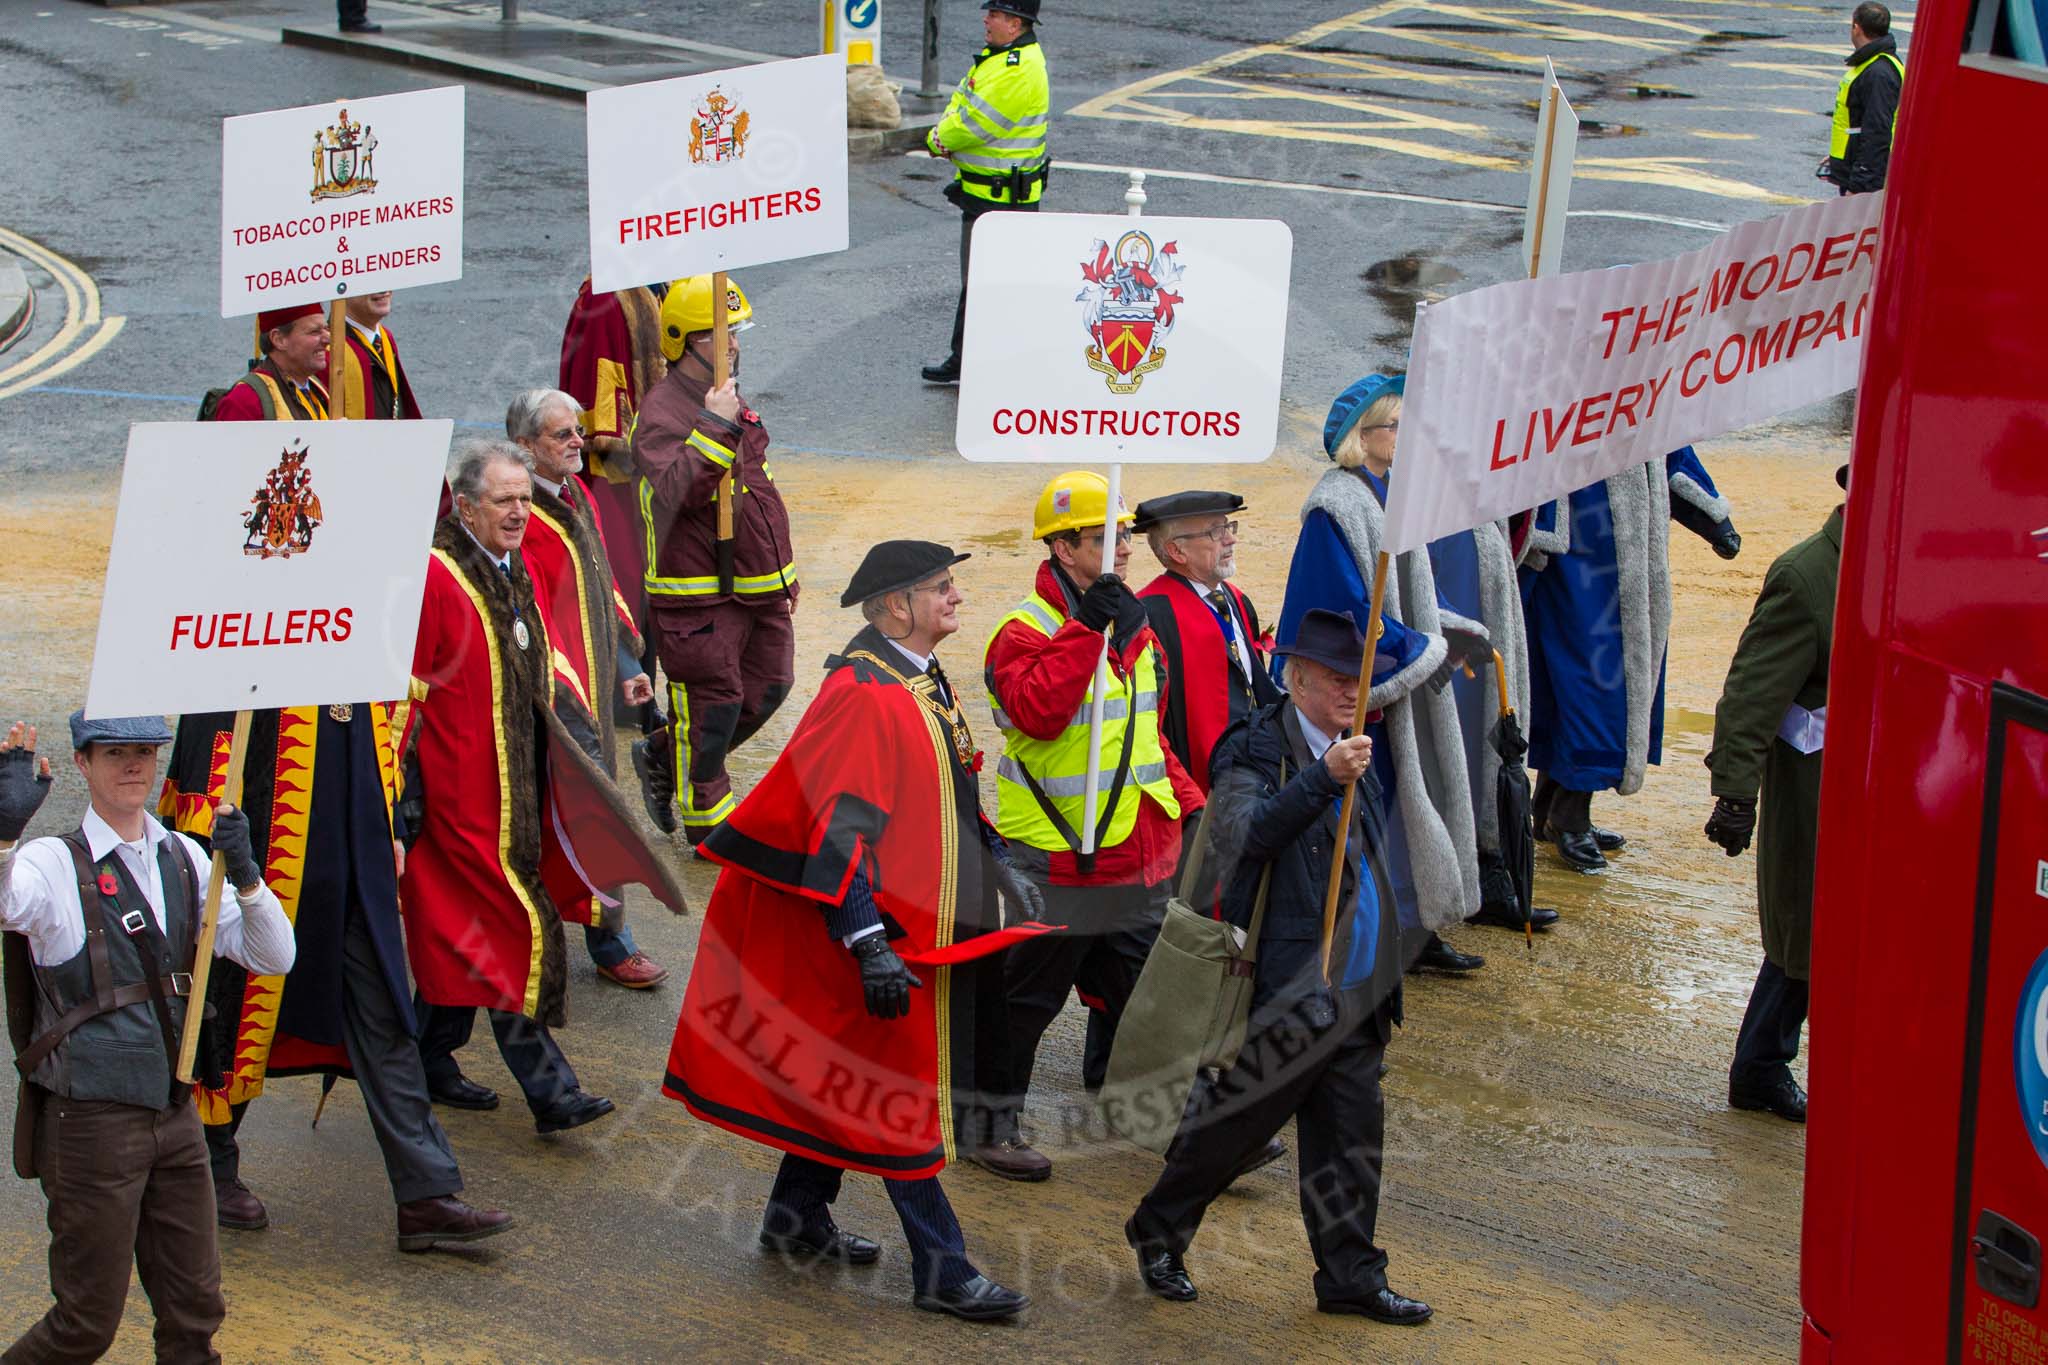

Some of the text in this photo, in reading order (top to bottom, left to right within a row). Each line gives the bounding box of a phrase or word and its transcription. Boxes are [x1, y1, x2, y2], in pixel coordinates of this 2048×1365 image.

[233, 196, 454, 247] TOBACCO PIPE MAKERS
[619, 187, 821, 244] FIREFIGHTERS
[245, 245, 441, 292] TOBACCO BLENDERS
[337, 236, 349, 253] &
[1601, 287, 1698, 359] THE
[992, 408, 1241, 436] CONSTRUCTORS
[1489, 367, 1673, 472] LIVERY
[170, 607, 353, 651] FUELLERS
